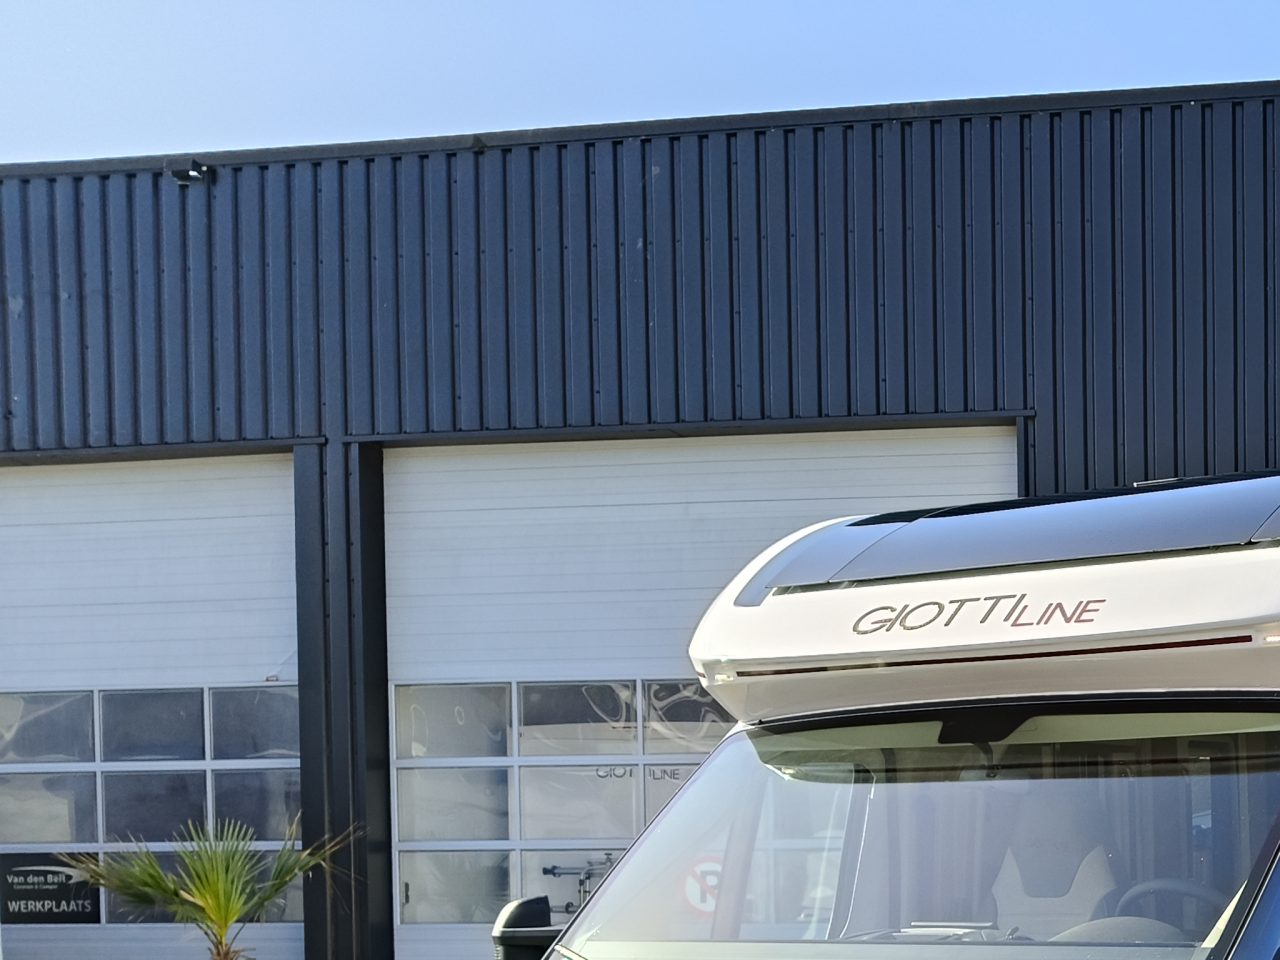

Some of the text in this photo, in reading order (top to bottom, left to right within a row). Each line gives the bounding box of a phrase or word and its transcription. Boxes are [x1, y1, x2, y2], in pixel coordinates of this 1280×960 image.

[7, 874, 25, 884] Van
[27, 874, 44, 884] den
[8, 900, 92, 913] WERKPLAATS
